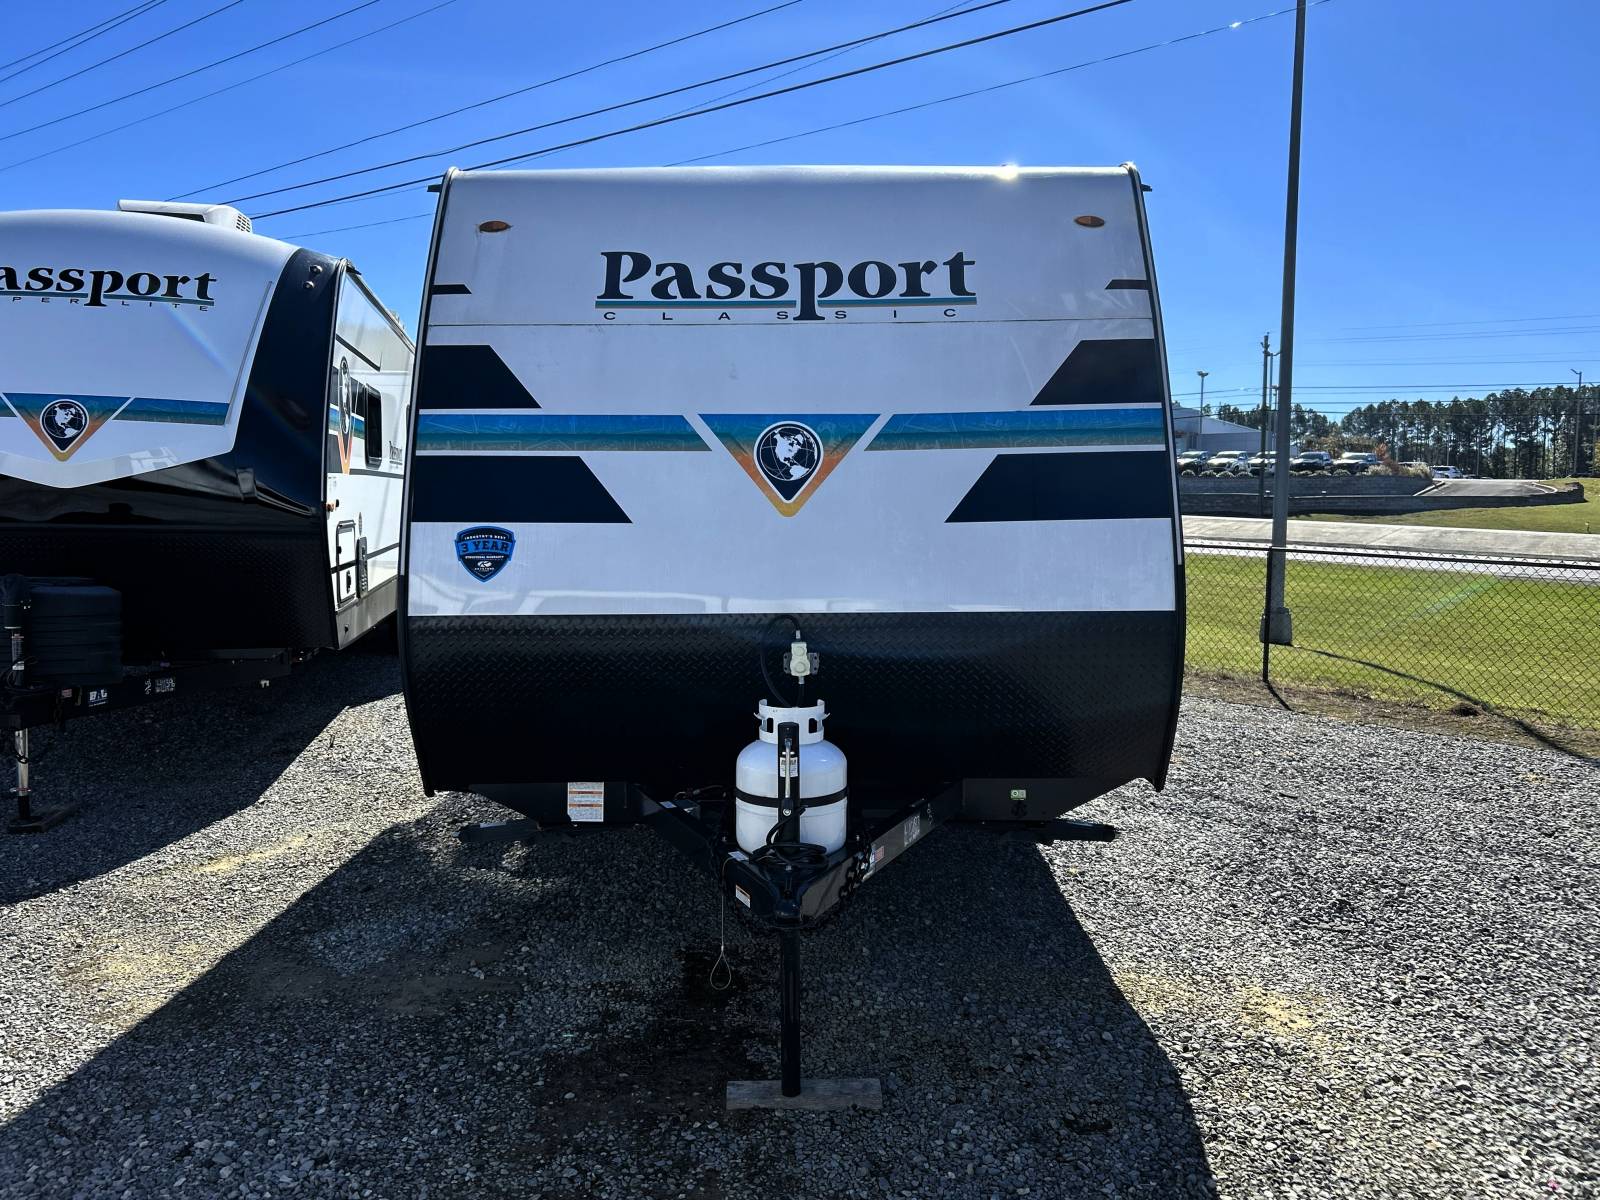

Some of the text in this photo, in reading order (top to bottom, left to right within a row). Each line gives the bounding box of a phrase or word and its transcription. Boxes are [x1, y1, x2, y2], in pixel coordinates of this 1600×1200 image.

[596, 251, 977, 321] Passport
[121, 301, 209, 312] LITE
[603, 308, 956, 321] CLASSIC
[460, 540, 510, 553] 3 YEAR
